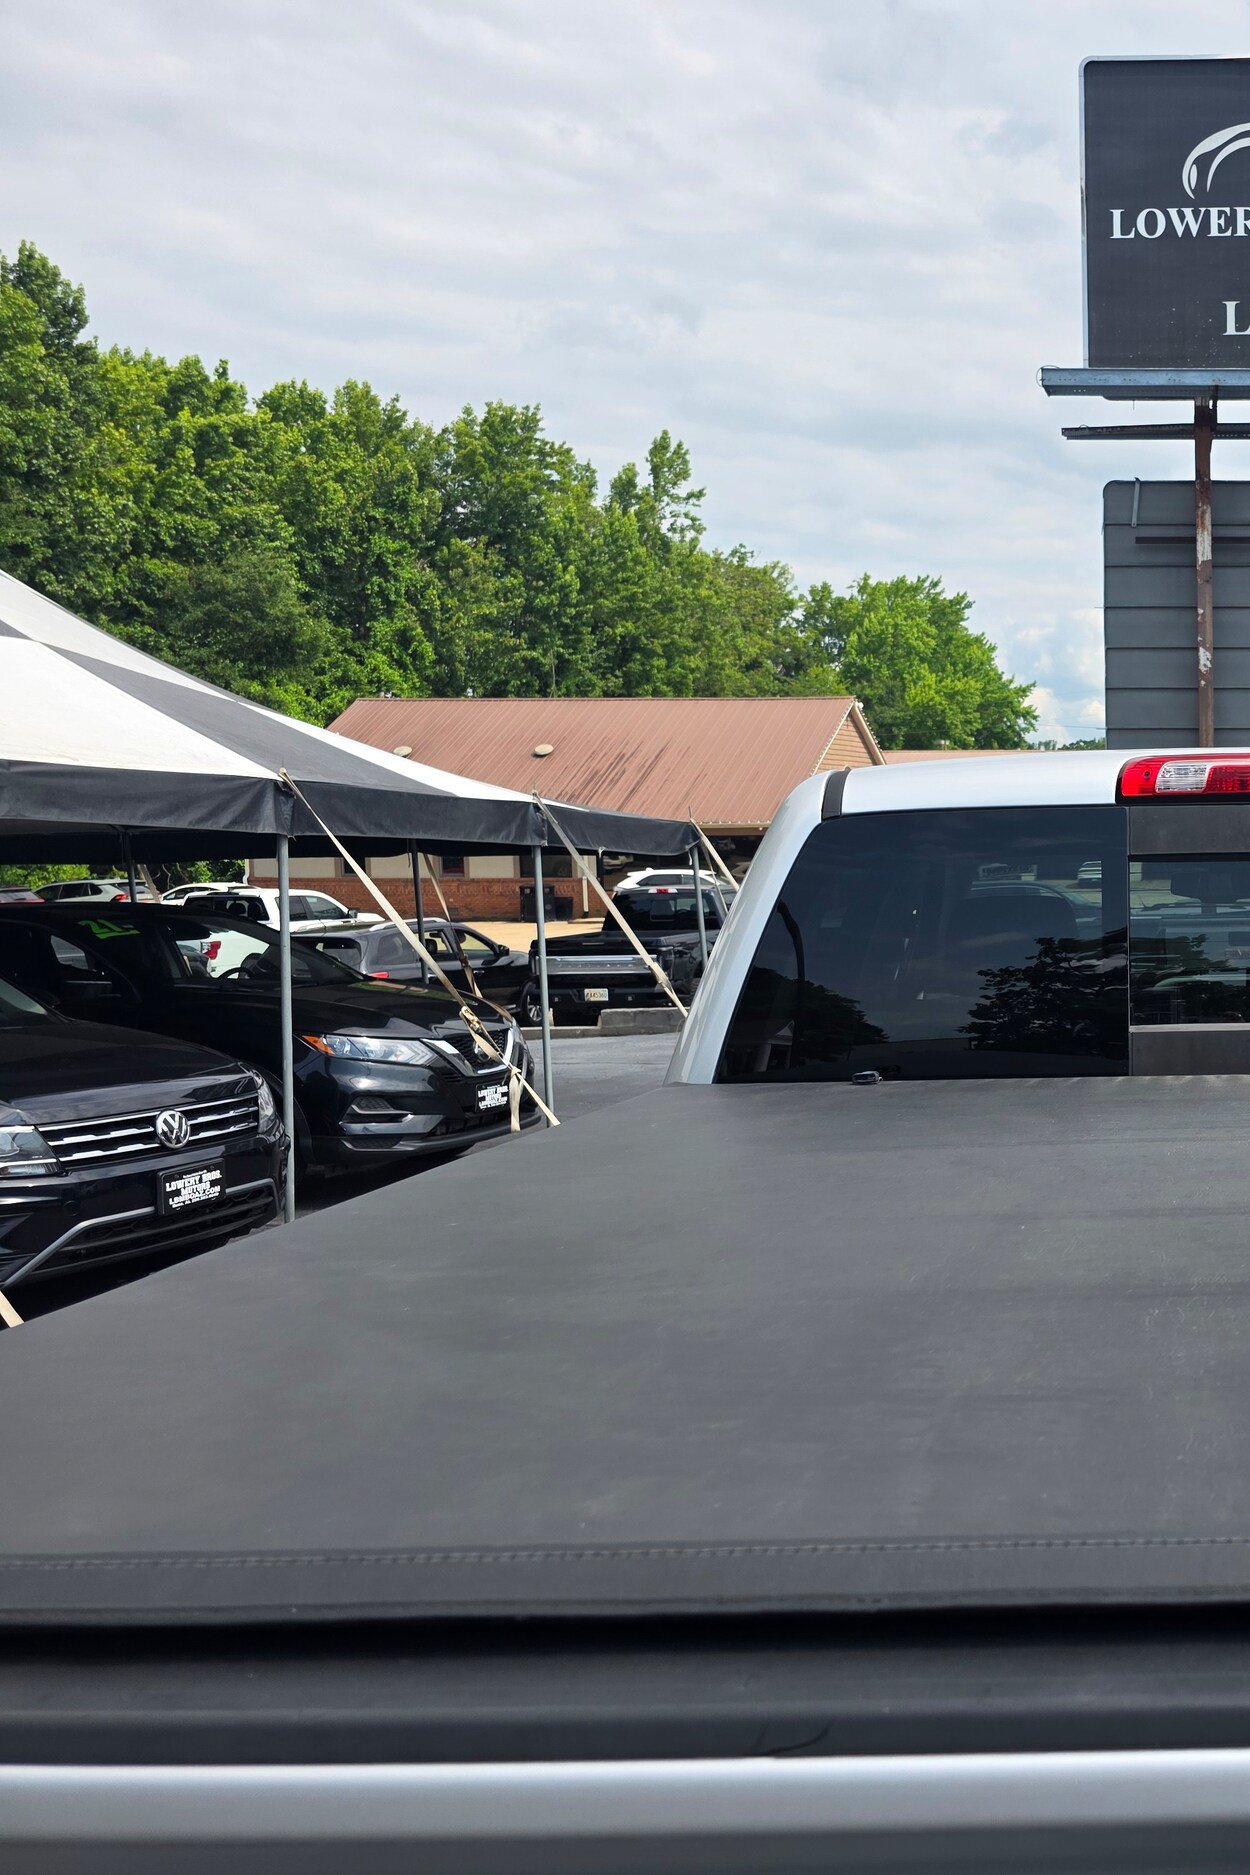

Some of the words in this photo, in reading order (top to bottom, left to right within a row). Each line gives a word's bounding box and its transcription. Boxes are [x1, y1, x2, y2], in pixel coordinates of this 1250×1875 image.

[165, 1176, 200, 1192] LOWERY
[201, 1169, 222, 1183] BROS.
[180, 1181, 210, 1196] MOTORS
